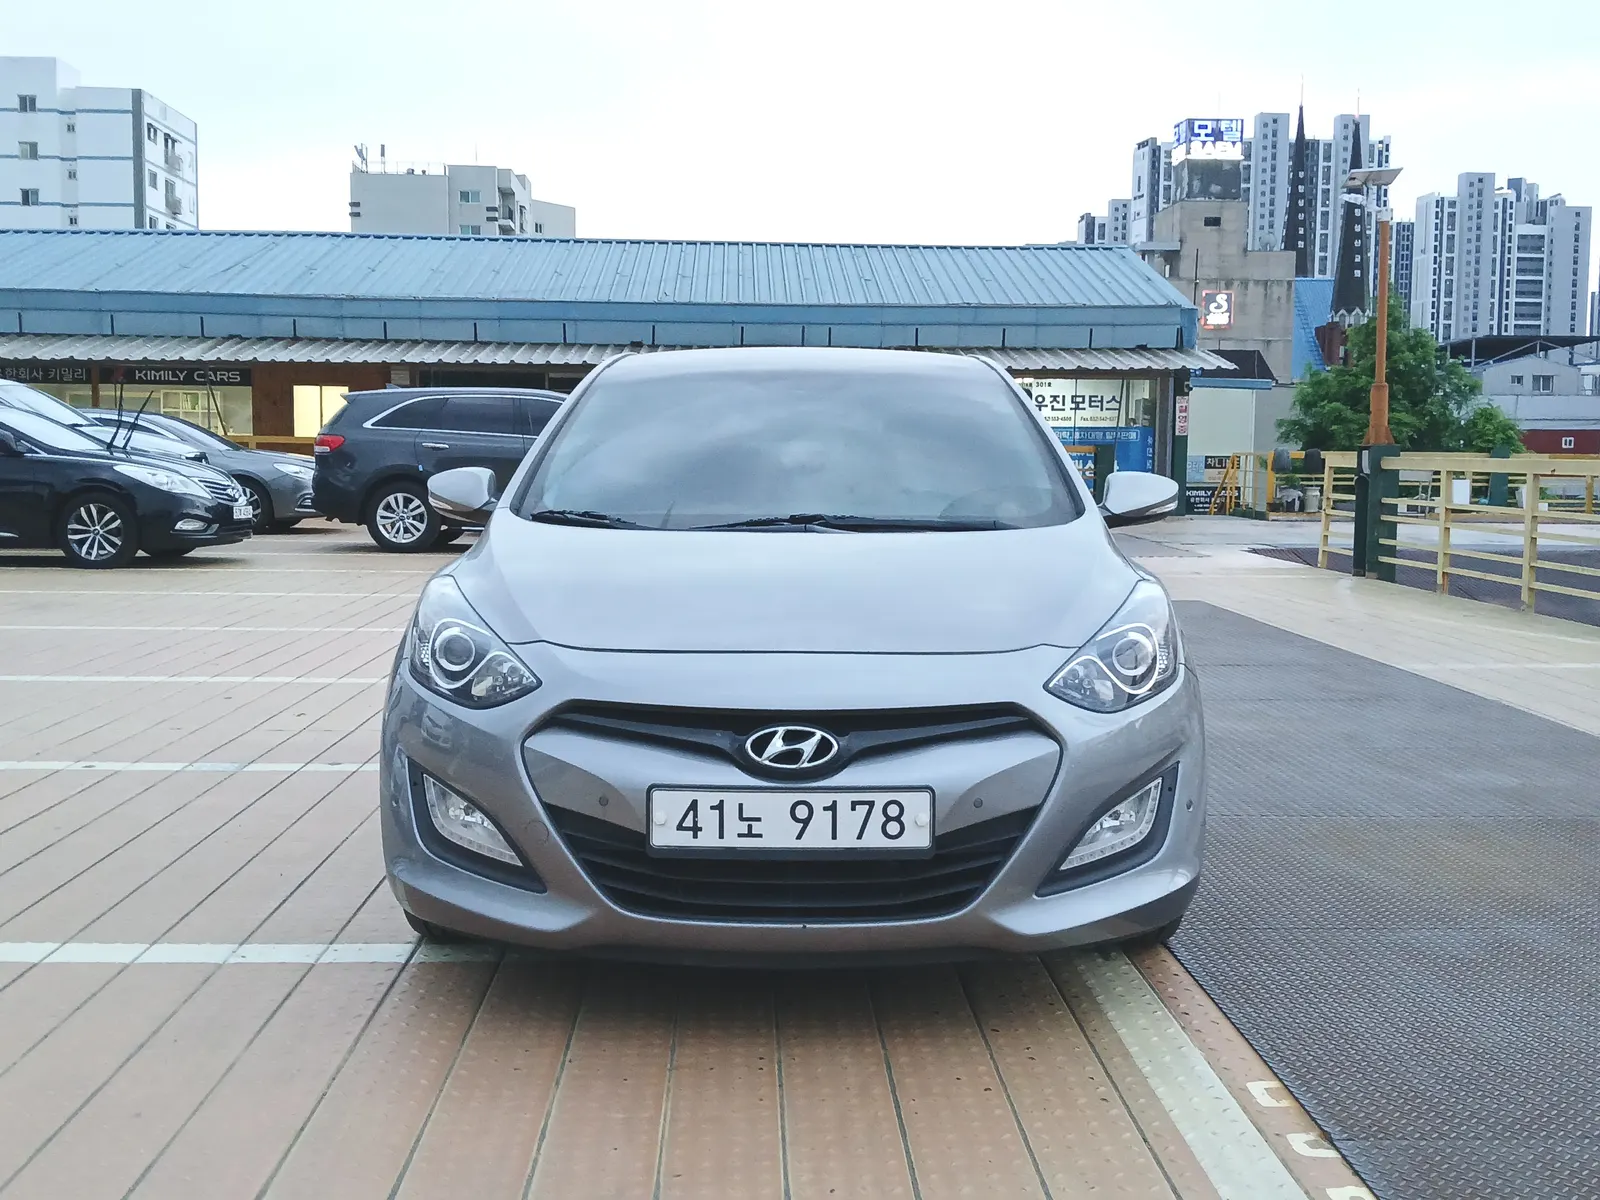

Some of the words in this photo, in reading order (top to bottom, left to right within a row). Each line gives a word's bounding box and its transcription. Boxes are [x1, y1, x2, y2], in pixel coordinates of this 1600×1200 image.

[1191, 120, 1242, 141] 모텔
[47, 367, 86, 381] 키밀리
[135, 369, 188, 381] KIMILY
[193, 371, 241, 382] CARS
[676, 799, 763, 840] 41노
[789, 799, 906, 841] 9178
